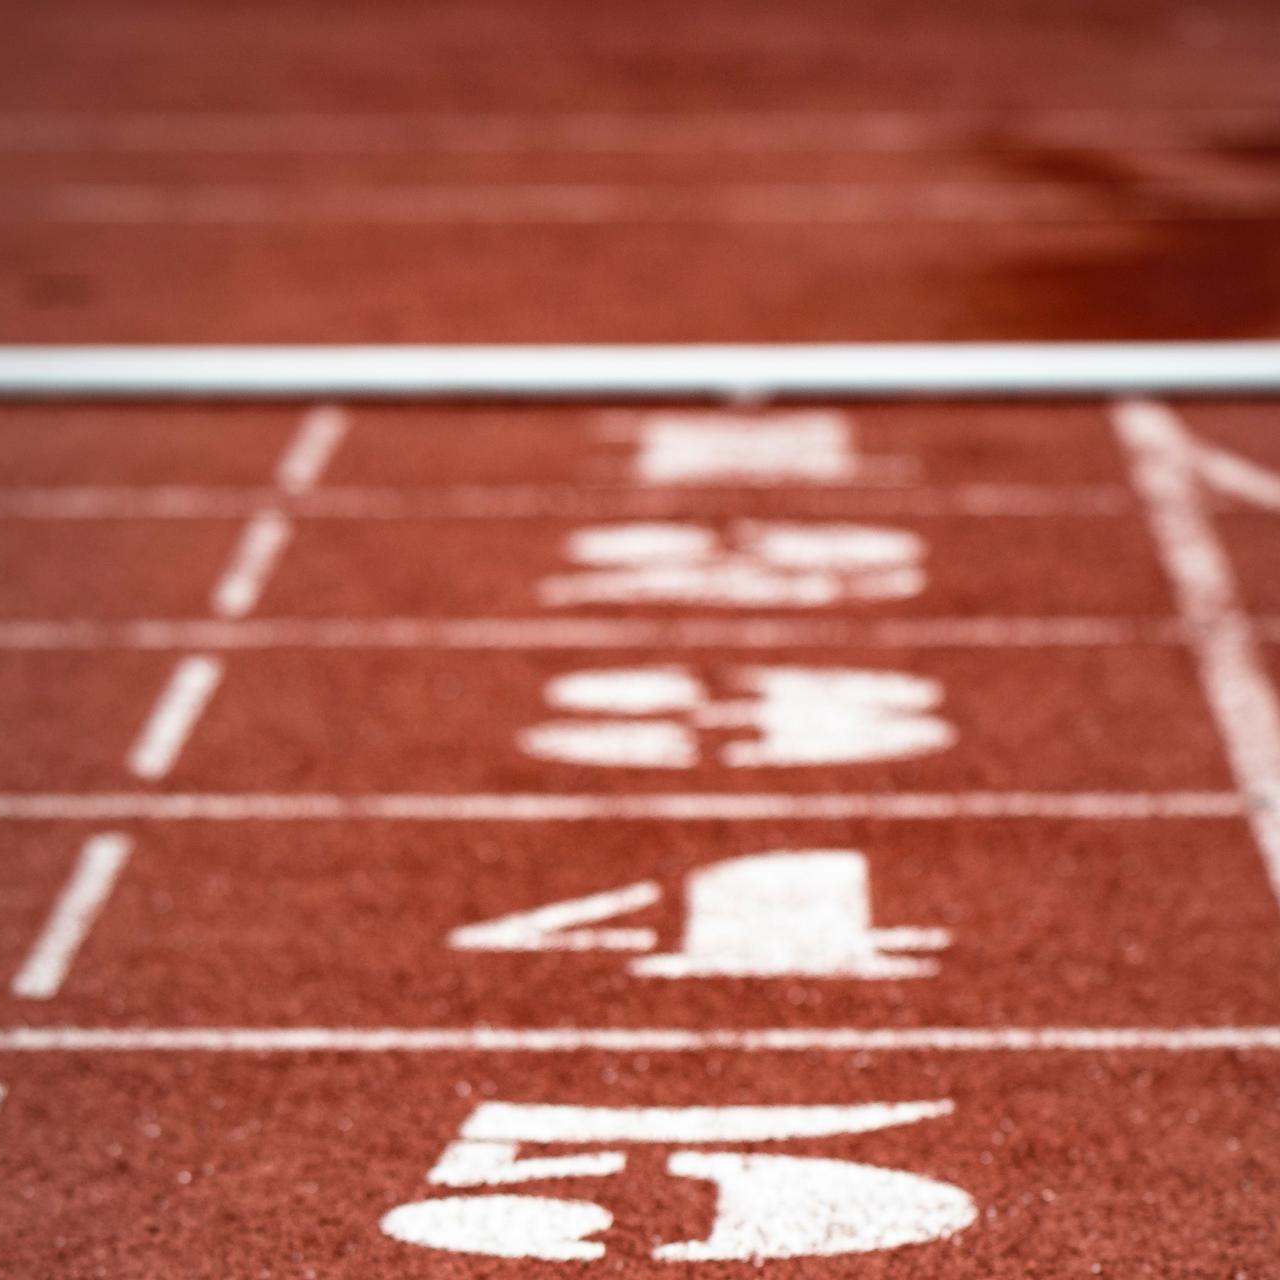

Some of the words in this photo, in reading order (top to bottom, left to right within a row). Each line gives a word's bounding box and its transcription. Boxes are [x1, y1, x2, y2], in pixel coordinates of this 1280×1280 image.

[536, 520, 928, 606] 2
[518, 665, 958, 769] 3
[448, 850, 953, 980] 4
[380, 1099, 978, 1262] 5
